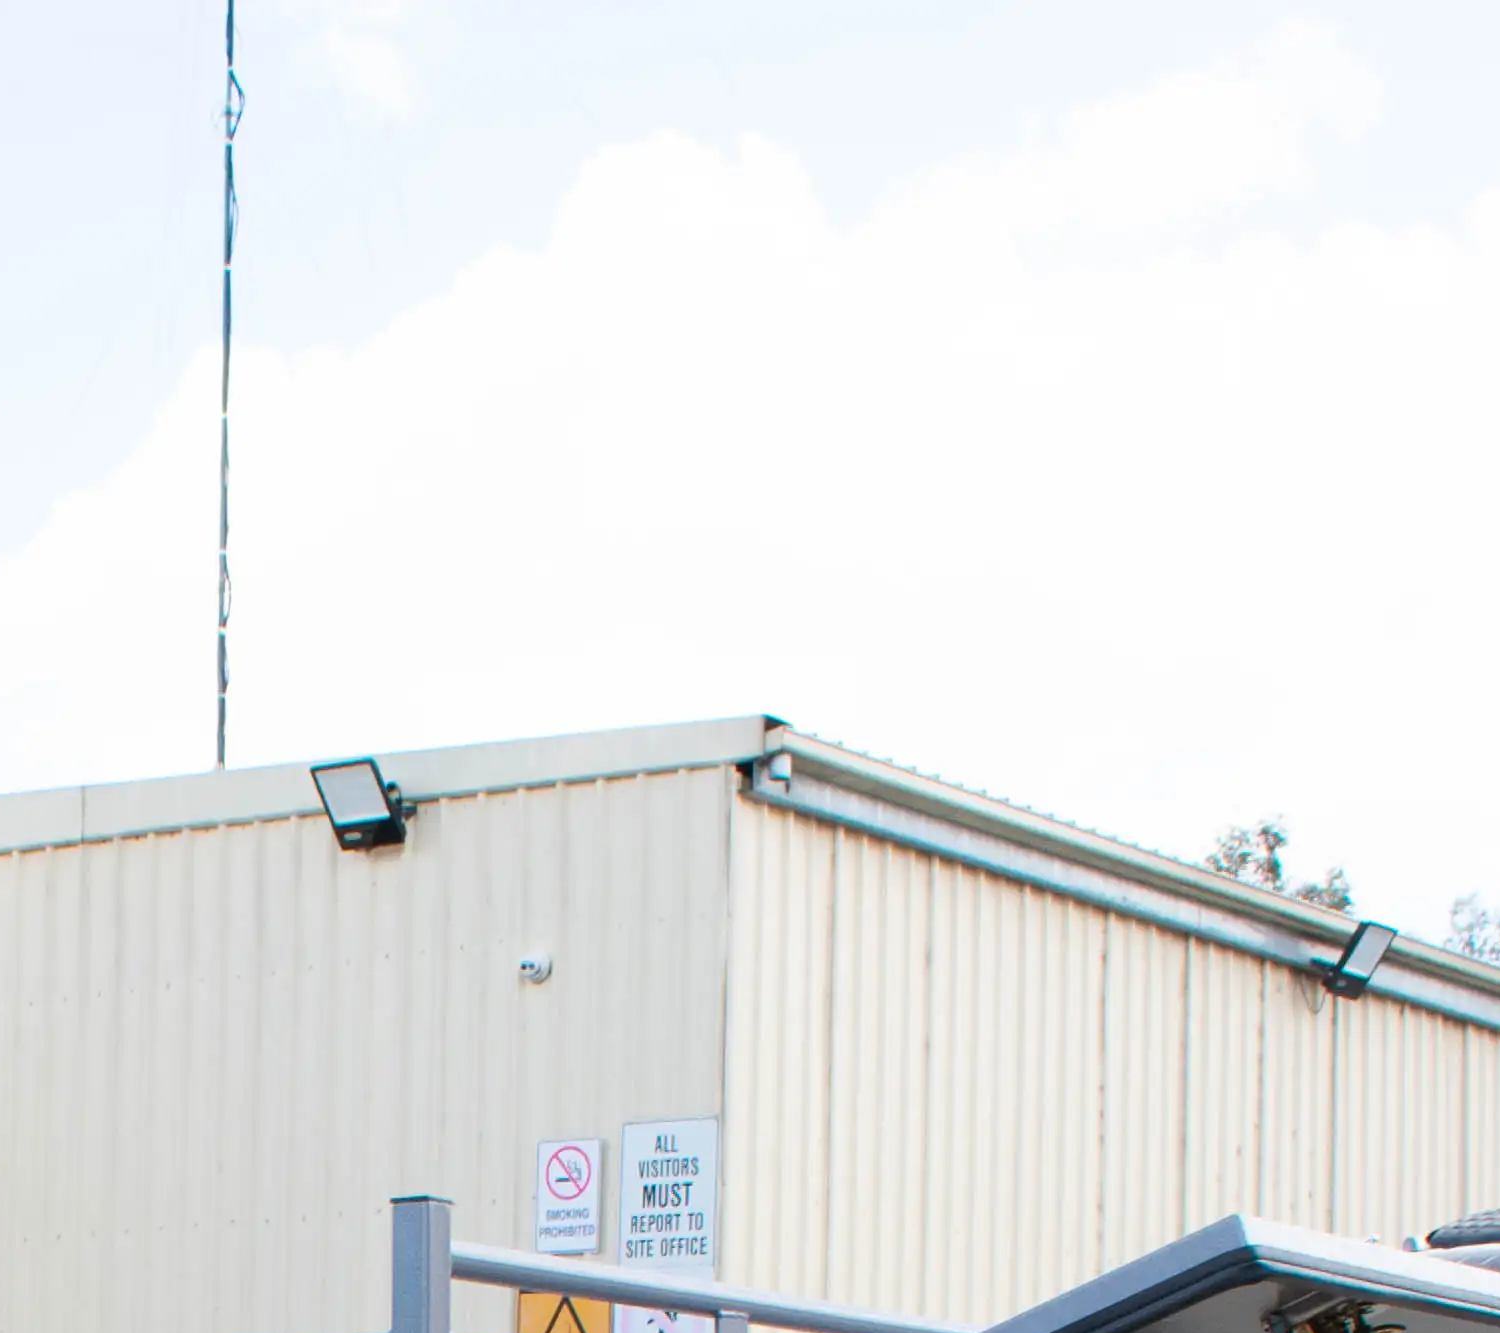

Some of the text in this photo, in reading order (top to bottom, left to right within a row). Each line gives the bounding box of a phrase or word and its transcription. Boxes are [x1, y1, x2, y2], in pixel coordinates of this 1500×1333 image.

[654, 1134, 678, 1153] ALL
[638, 1157, 699, 1178] VISITORS
[642, 1181, 692, 1208] MUST
[630, 1211, 704, 1234] REPORT TO
[625, 1236, 708, 1259] SITE OFFICE
